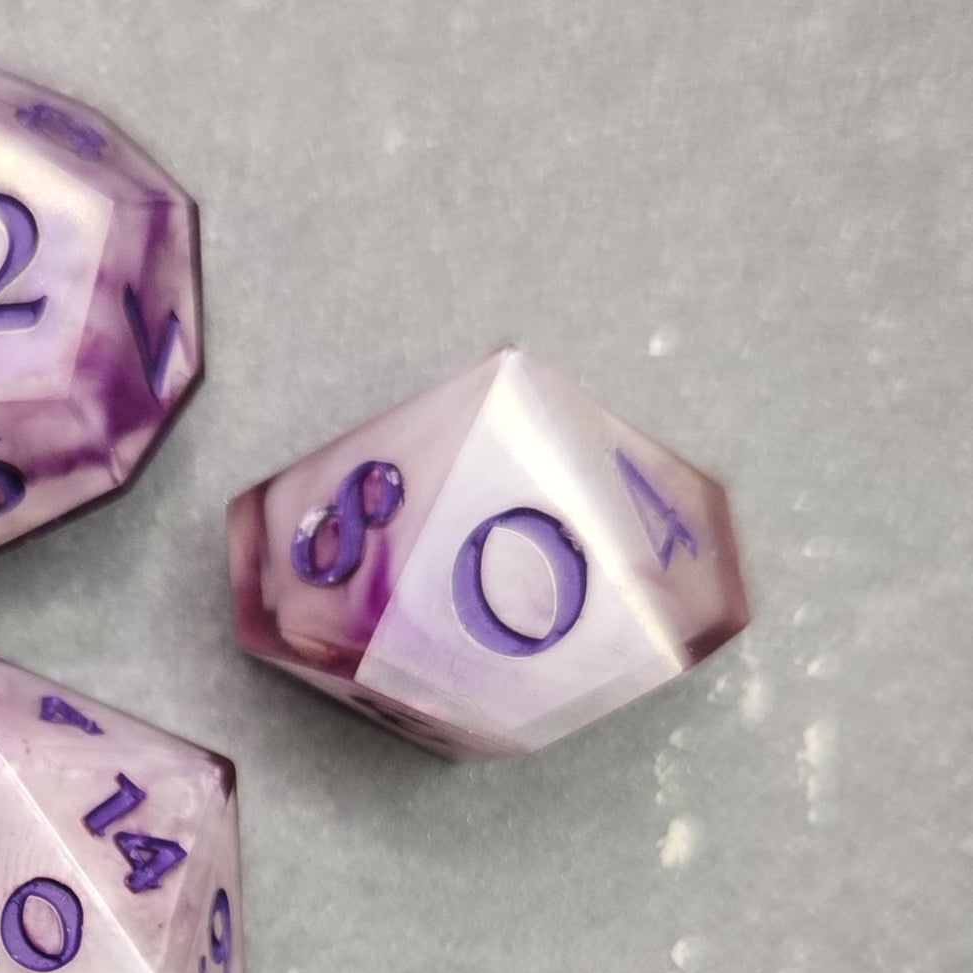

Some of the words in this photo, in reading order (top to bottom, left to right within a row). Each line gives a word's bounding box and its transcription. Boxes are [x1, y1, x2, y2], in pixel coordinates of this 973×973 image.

[290, 460, 406, 588] 8
[615, 446, 699, 572] 4
[451, 506, 589, 660] 0
[81, 771, 188, 895] 14
